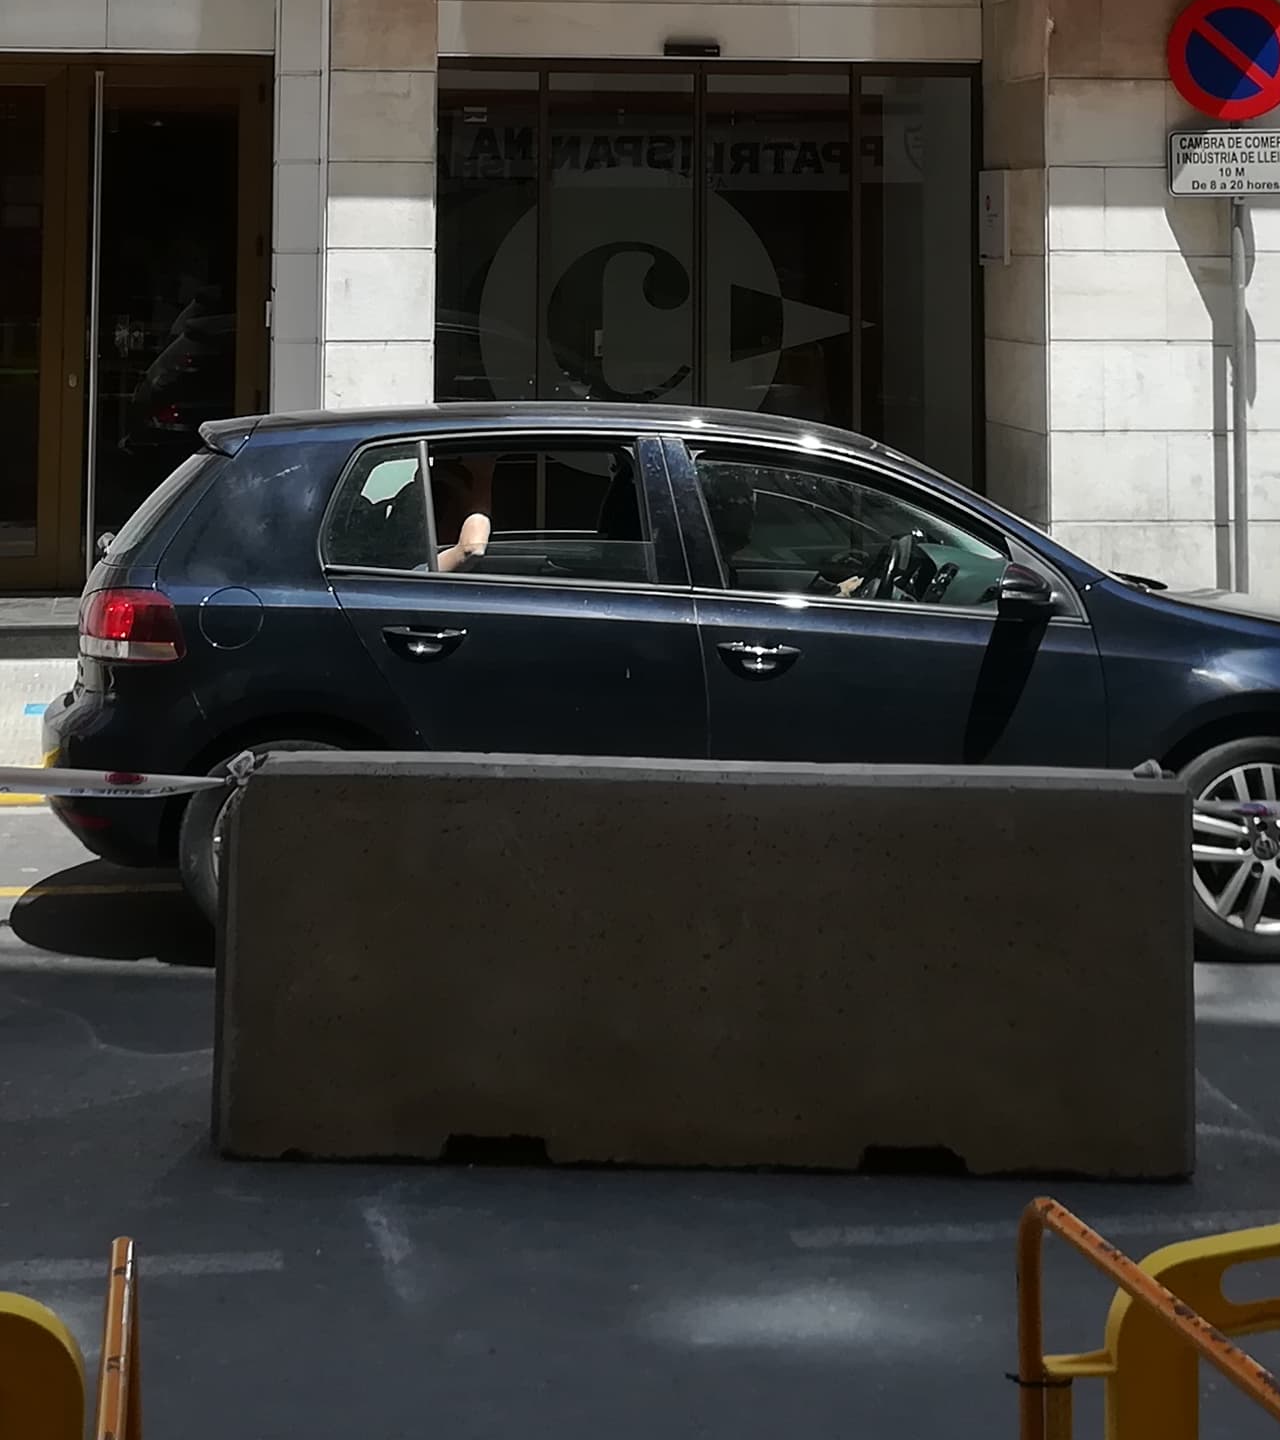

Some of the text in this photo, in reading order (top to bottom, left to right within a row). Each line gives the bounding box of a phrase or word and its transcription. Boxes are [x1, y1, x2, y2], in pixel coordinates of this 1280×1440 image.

[1179, 136, 1225, 150] CAMBRA
[1227, 136, 1242, 149] DE
[1182, 149, 1239, 164] INDÚSTRIA
[1240, 151, 1255, 163] DE
[1219, 167, 1246, 177] 10 M
[1191, 180, 1280, 190] De 8 a 20 hores
